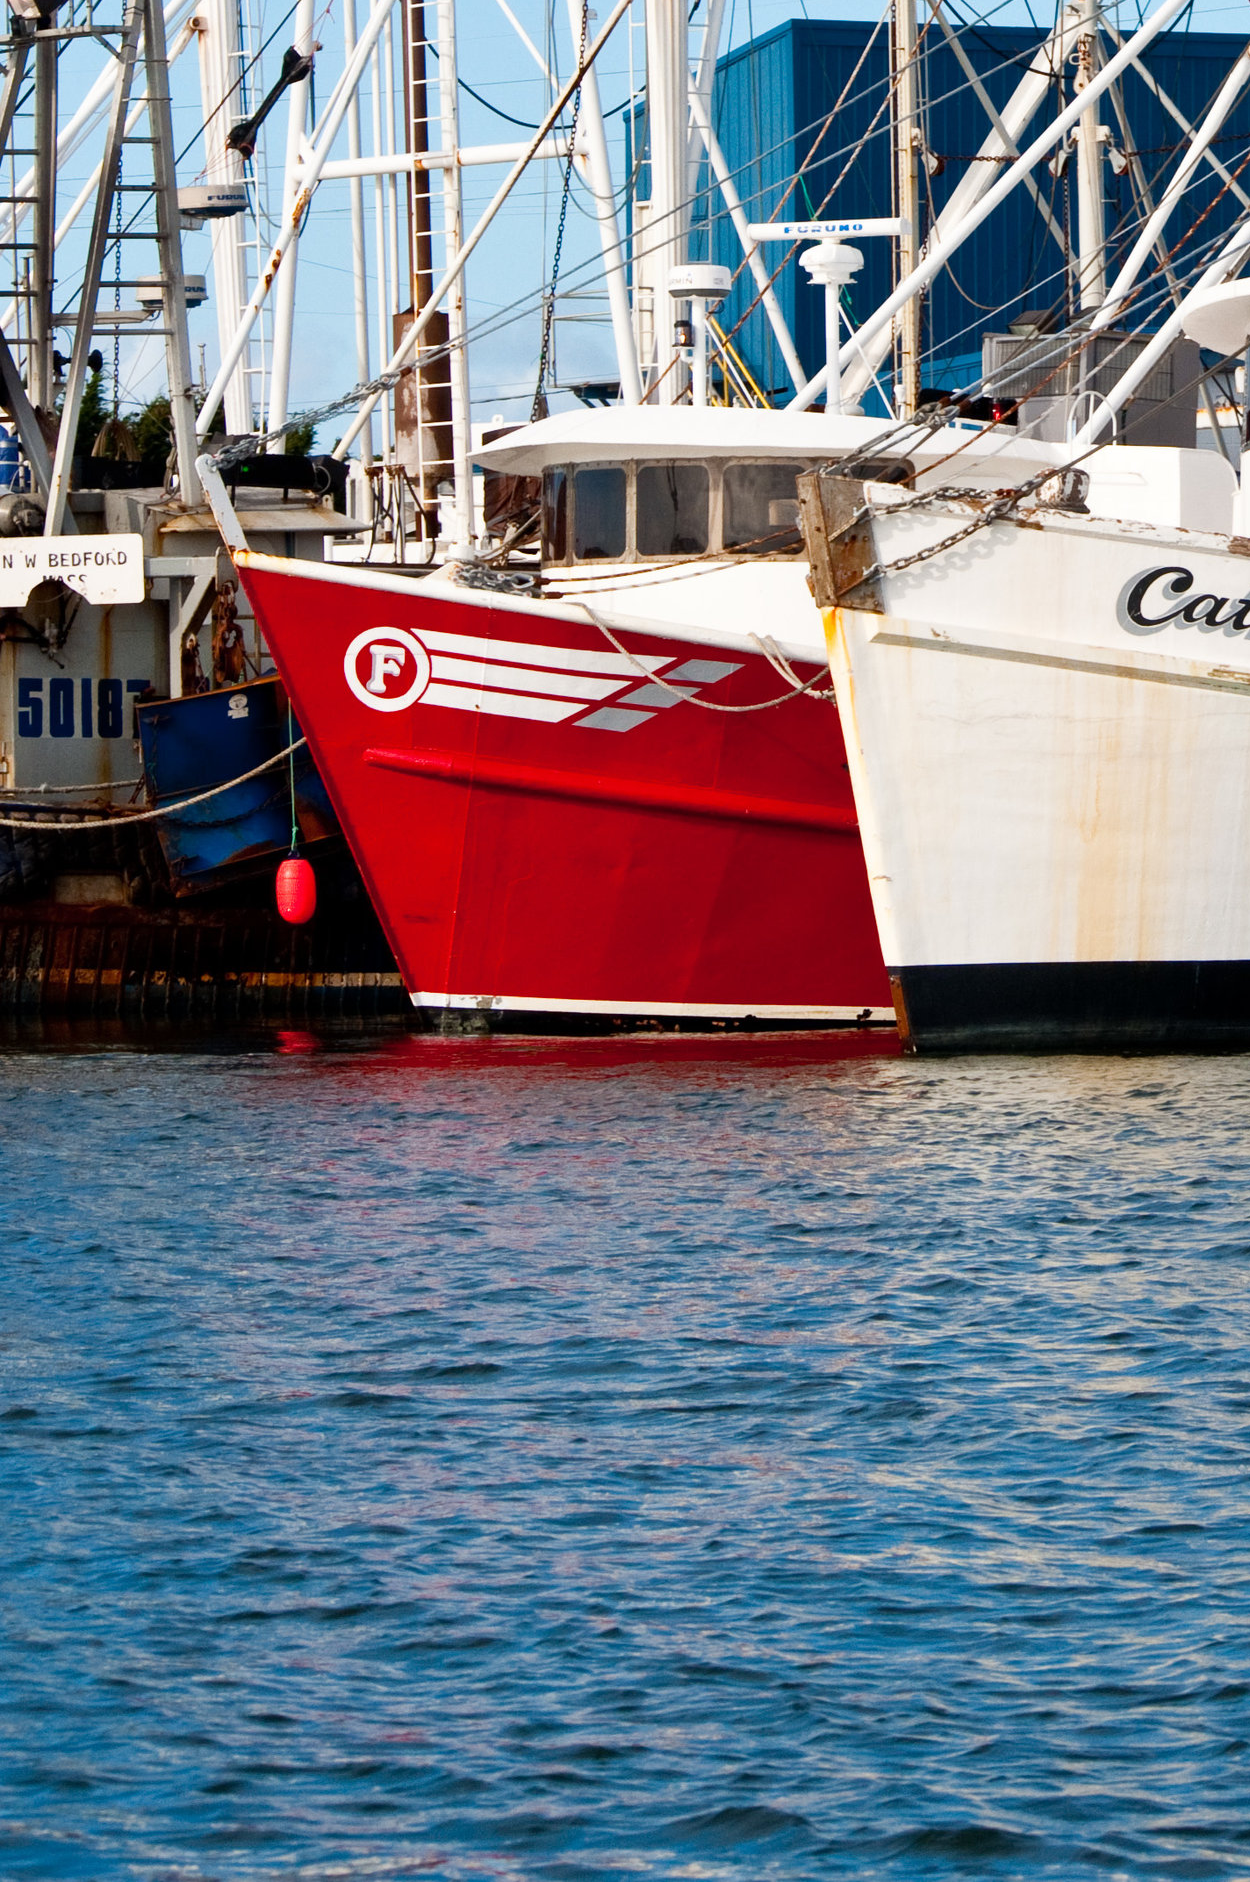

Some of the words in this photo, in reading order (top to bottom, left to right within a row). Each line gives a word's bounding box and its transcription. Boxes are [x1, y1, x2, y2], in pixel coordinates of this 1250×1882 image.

[784, 223, 863, 234] FURUNO
[25, 553, 36, 568] W
[48, 551, 127, 568] BEDFORD
[366, 644, 405, 693] F
